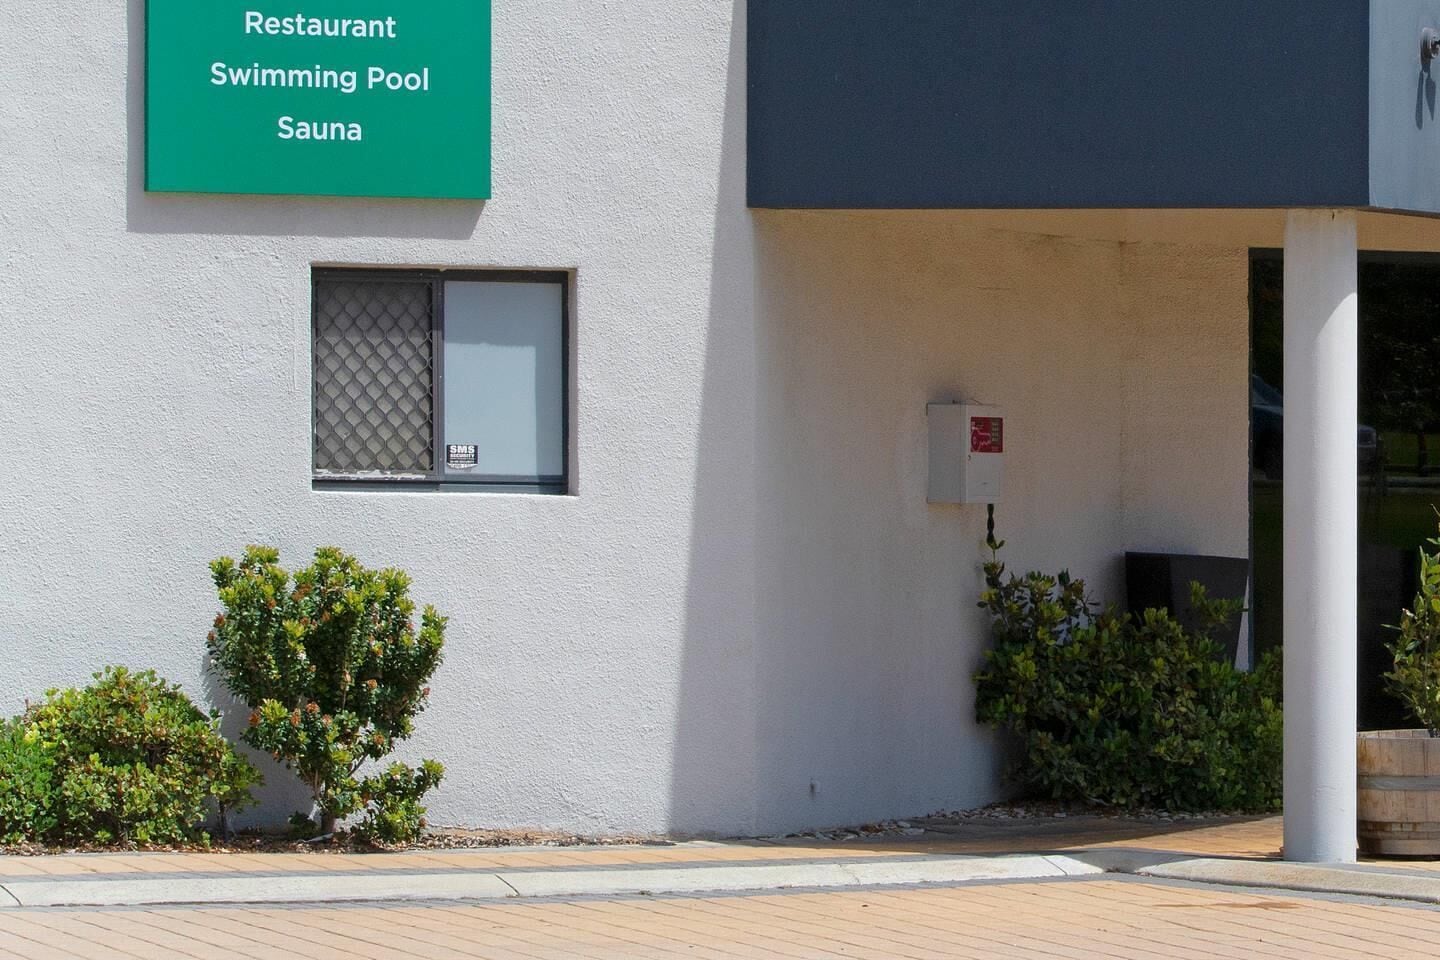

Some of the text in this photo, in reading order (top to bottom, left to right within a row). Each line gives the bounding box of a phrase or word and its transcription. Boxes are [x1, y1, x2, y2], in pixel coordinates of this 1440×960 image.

[245, 11, 396, 39] Restaurant
[210, 62, 430, 93] Swimming Pool
[277, 116, 363, 141] Sauna
[450, 445, 475, 453] SMS
